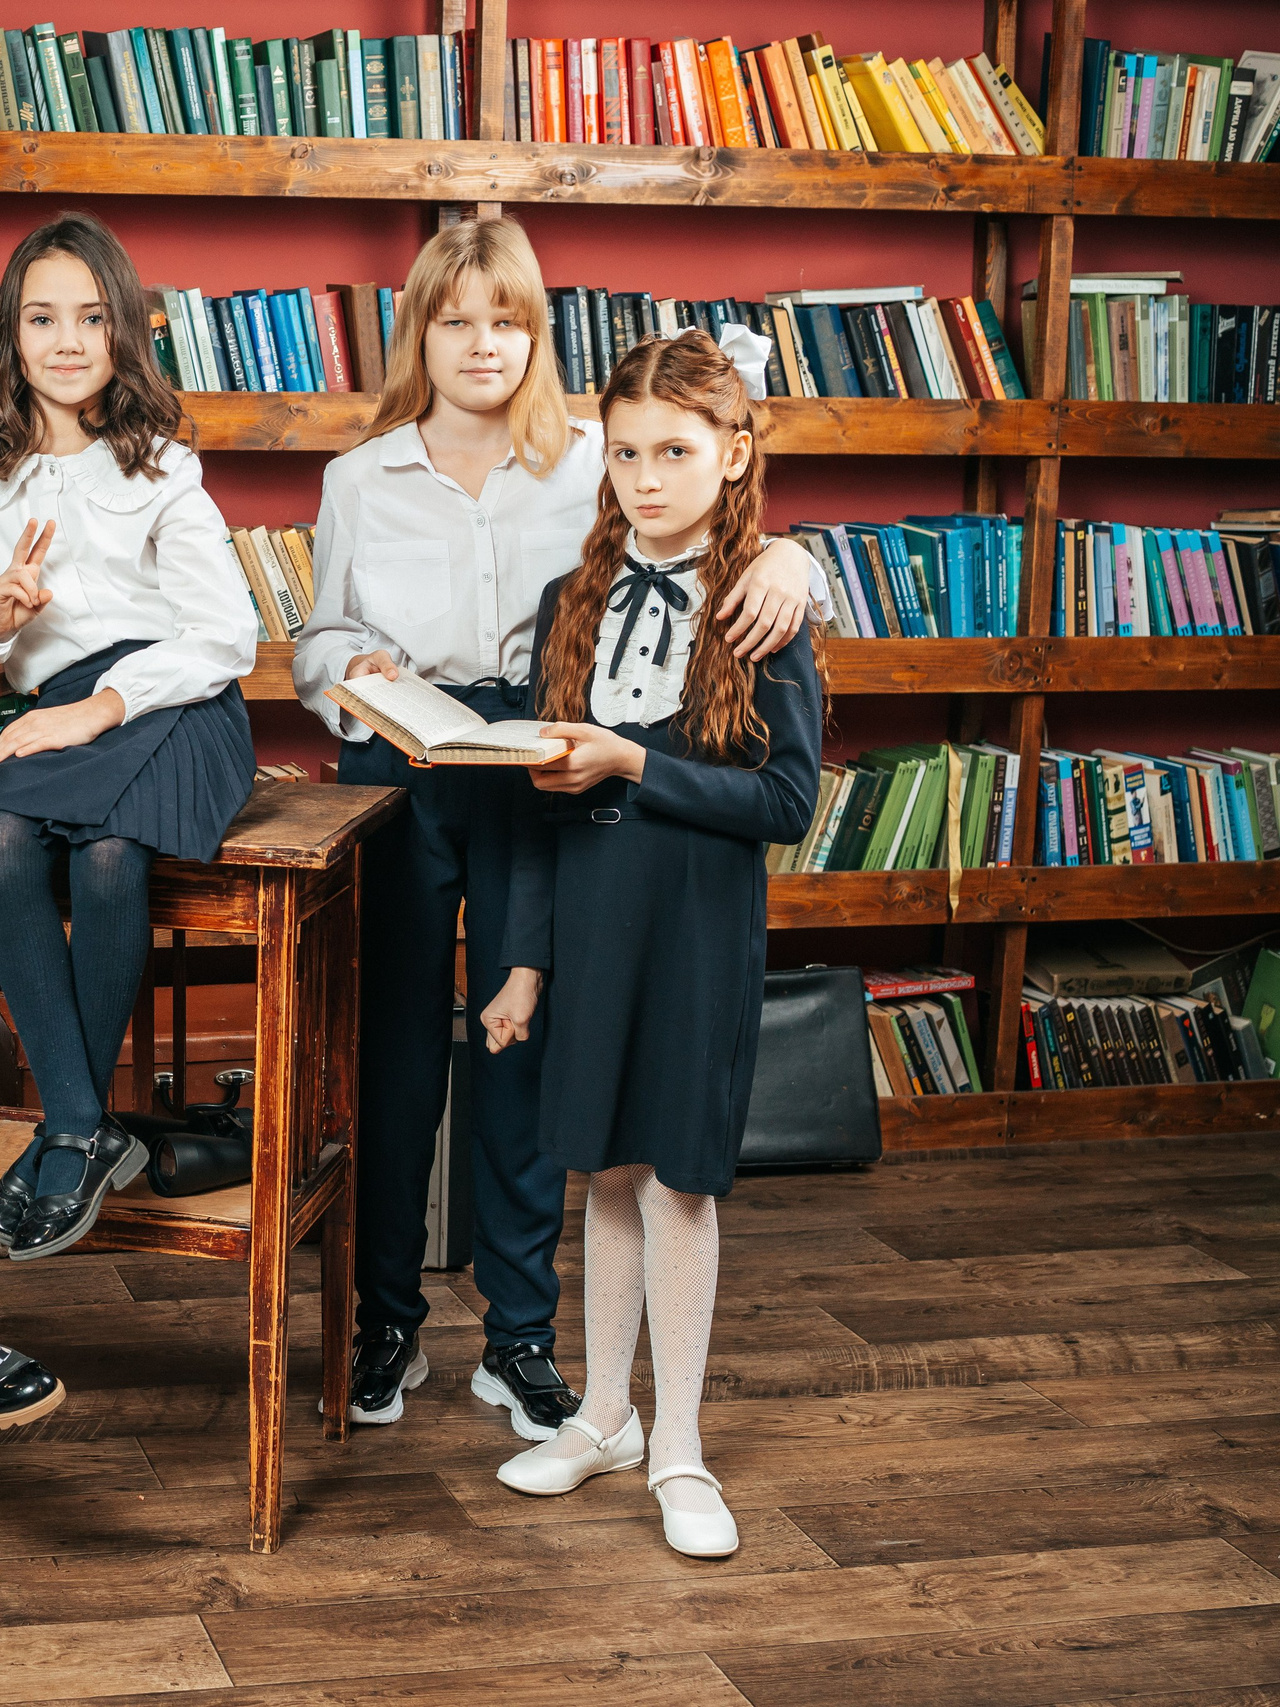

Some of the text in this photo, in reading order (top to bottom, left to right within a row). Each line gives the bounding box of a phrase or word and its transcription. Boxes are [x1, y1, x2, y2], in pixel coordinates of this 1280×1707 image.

[1265, 358, 1277, 401] ЗАБЫТЫЙ
[287, 544, 303, 572] ИСТОРИЯ
[275, 586, 300, 626] ПРОЛОГ
